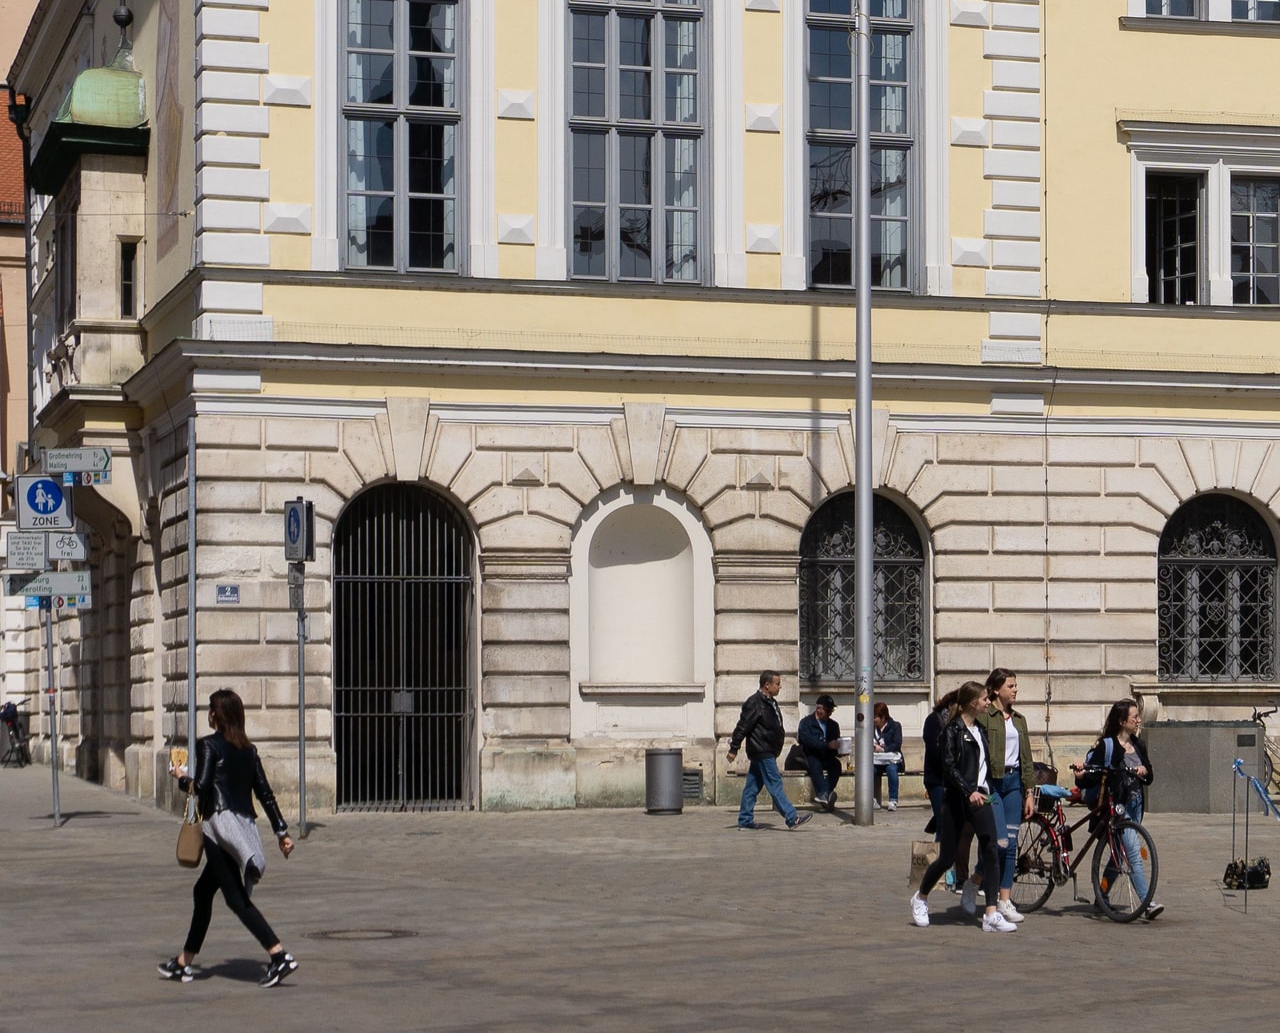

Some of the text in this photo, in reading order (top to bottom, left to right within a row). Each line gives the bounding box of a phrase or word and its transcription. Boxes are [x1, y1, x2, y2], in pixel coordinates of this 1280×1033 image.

[49, 462, 68, 470] Mailing
[32, 517, 60, 526] ZONE
[61, 550, 73, 558] frei
[20, 576, 50, 585] Neburg
[20, 585, 53, 594] Gerolfing
[225, 586, 231, 595] 2
